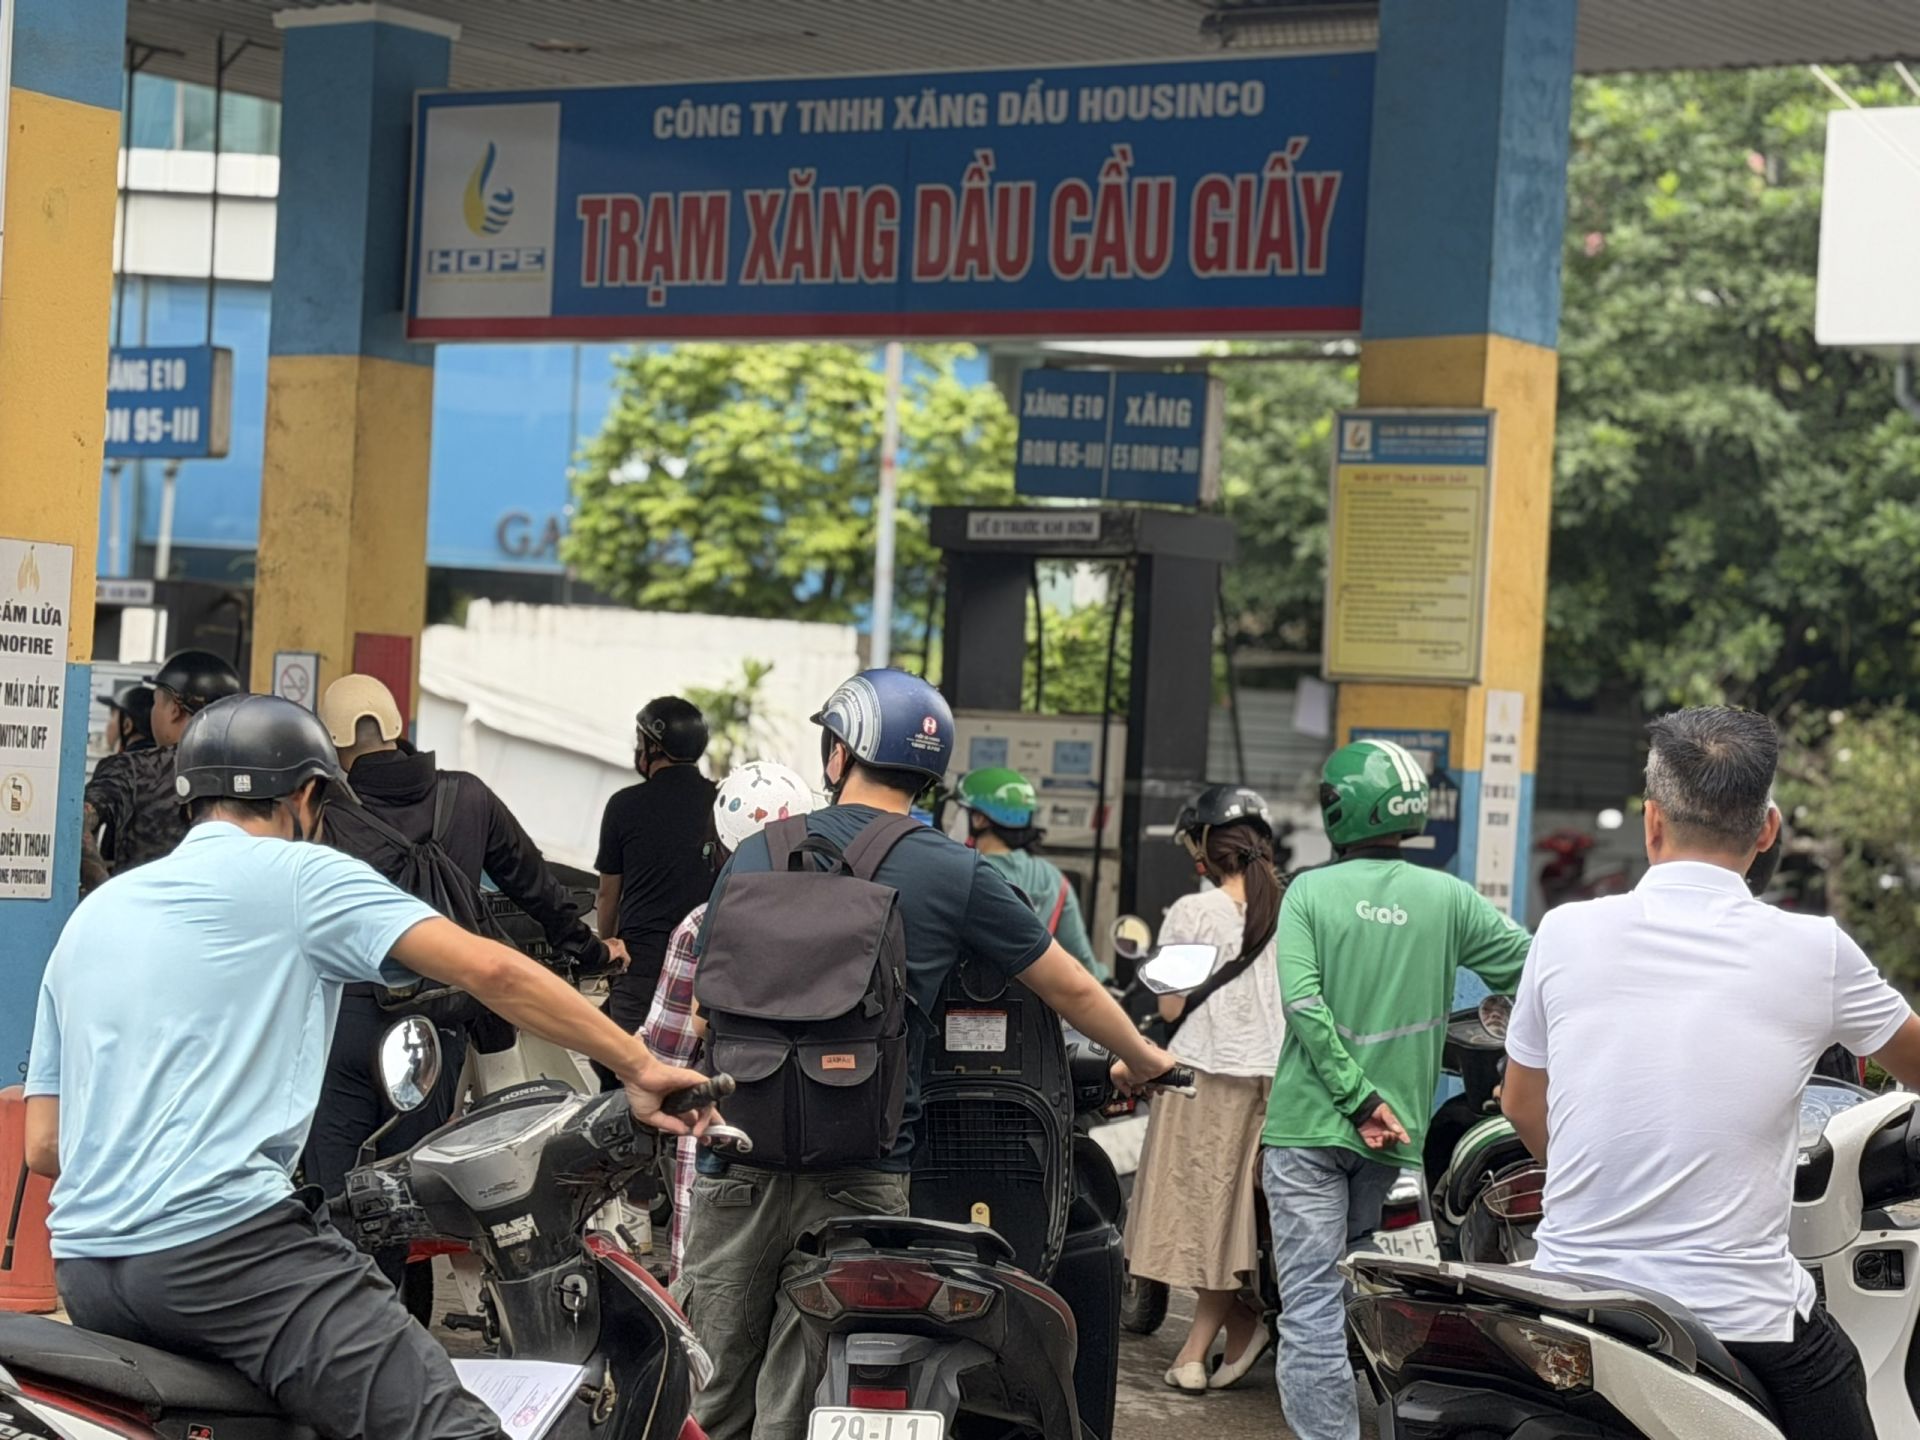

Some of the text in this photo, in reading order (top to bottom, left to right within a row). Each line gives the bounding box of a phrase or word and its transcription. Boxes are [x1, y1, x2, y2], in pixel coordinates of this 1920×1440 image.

[653, 98, 741, 139] CÔNG
[750, 100, 788, 135] TY
[797, 97, 884, 133] TNHH
[893, 88, 987, 130] XĂNG
[1078, 80, 1265, 124] HOUSINCO
[577, 136, 1342, 307] TRẠM XĂNG DẦU CẦU GIẤY
[428, 247, 545, 274] HOPE
[151, 358, 186, 391] E10
[1023, 387, 1104, 419] XĂNG E10
[1124, 391, 1192, 427] XĂNG
[134, 406, 199, 442] 95-III
[0, 598, 62, 626] ẤM LỬA
[0, 633, 54, 655] NOFIRE
[4, 677, 25, 707] MÁY
[47, 685, 60, 709] XE
[31, 725, 48, 750] OFF
[1388, 791, 1428, 816] Grab
[24, 833, 50, 863] THOẠI
[1355, 900, 1408, 926] Grab
